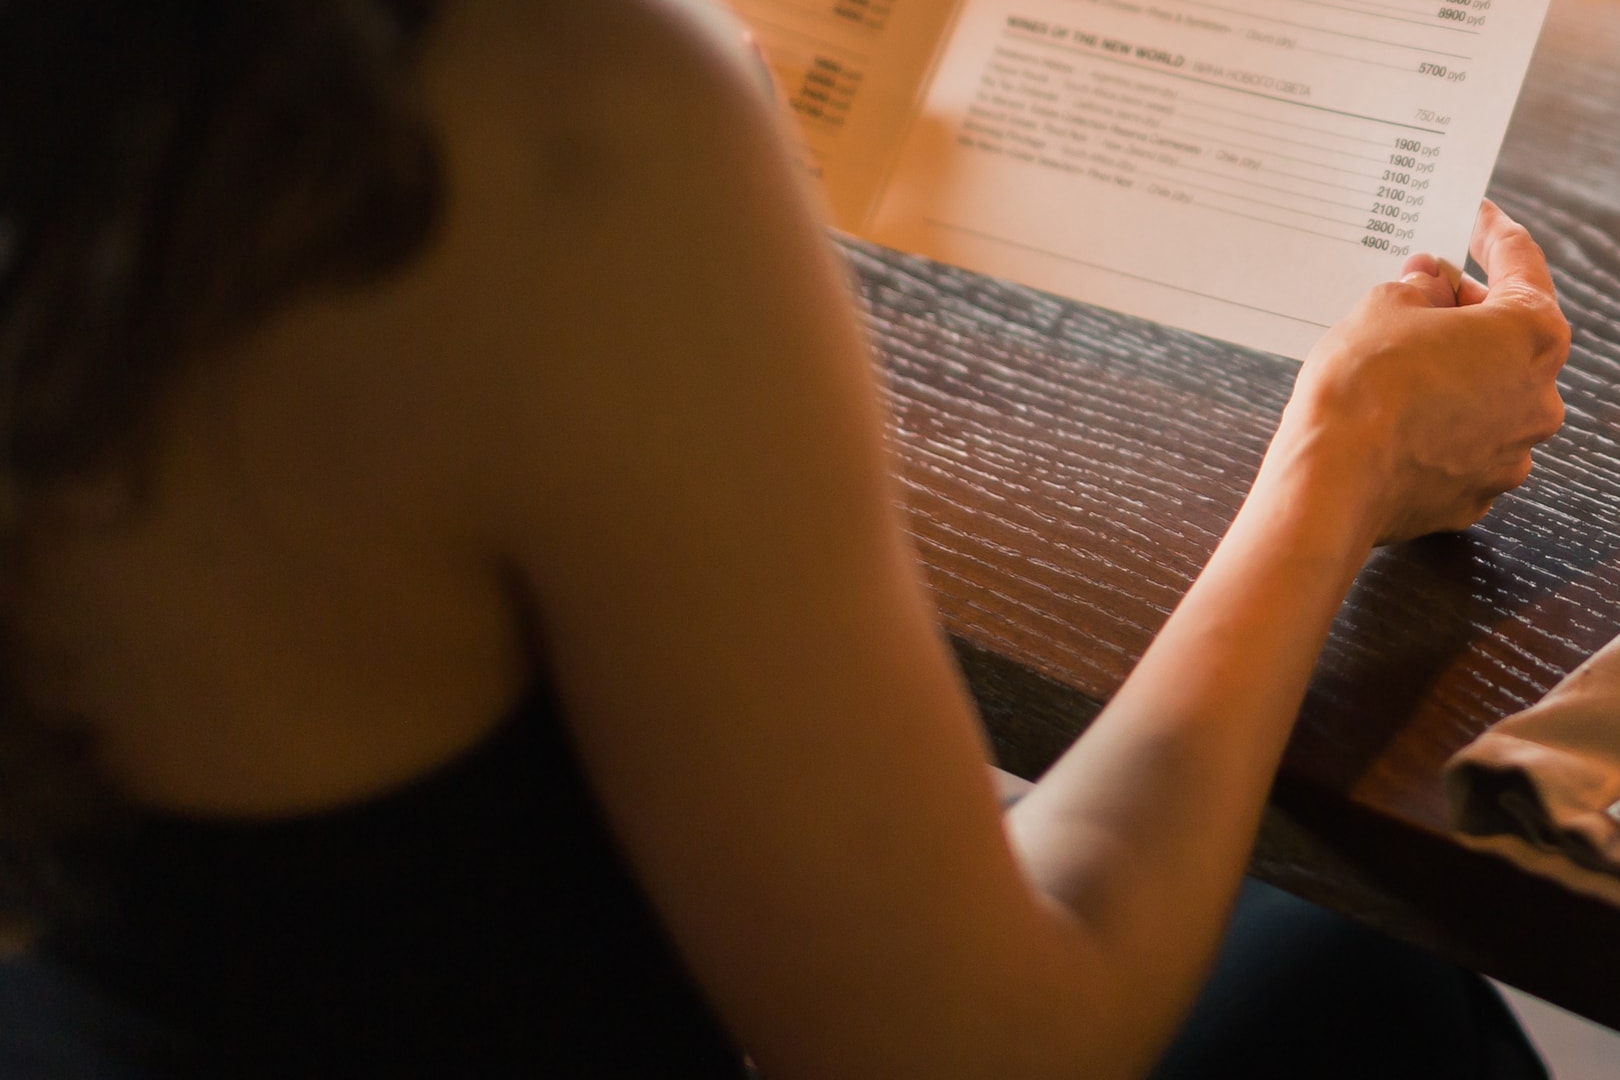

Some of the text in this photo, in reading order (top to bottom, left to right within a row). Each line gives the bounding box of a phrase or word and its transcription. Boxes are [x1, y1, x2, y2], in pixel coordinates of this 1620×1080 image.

[1471, 0, 1492, 11] руб
[1437, 7, 1486, 27] 8900 руб
[1005, 15, 1050, 36] WINES
[1050, 26, 1069, 41] OF
[1071, 31, 1099, 48] THE
[1100, 37, 1134, 56] NEW
[1134, 45, 1186, 69] WORLD
[1418, 62, 1467, 83] 5700 руб
[1413, 108, 1436, 123] 750
[1395, 138, 1441, 158] 1900 руб
[1389, 154, 1435, 174] 1900 руб
[1381, 169, 1430, 191] 3100 руб
[1376, 185, 1425, 207] 2100 руб
[1370, 202, 1420, 224] 2100 руб
[1365, 218, 1415, 240] 2800 руб
[1360, 235, 1410, 257] 4900 руб
